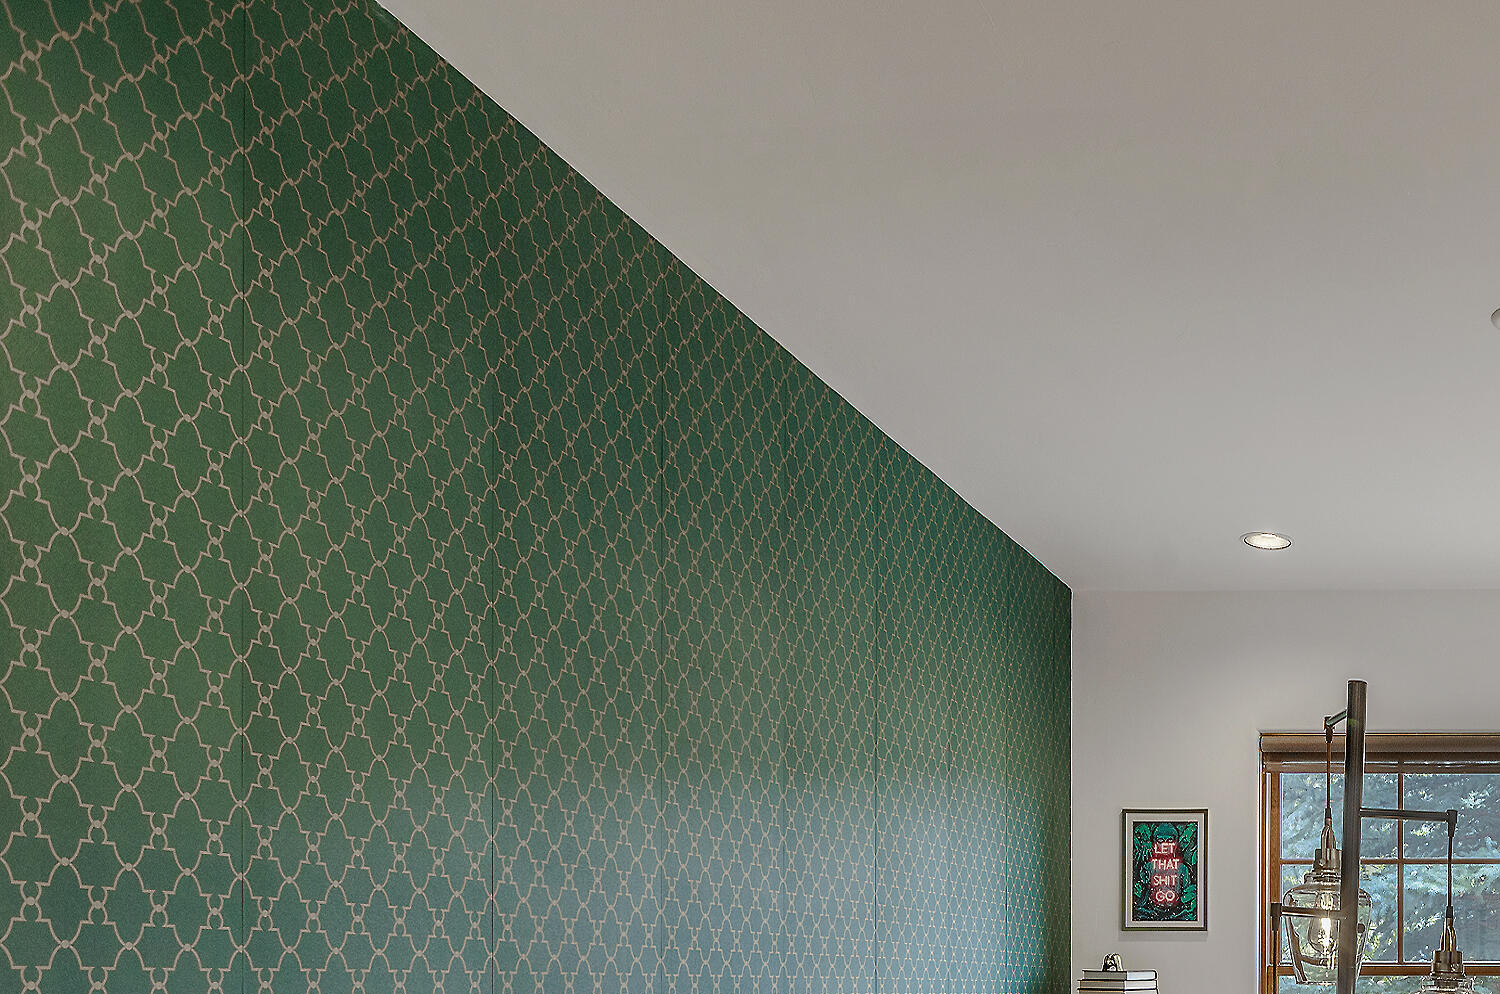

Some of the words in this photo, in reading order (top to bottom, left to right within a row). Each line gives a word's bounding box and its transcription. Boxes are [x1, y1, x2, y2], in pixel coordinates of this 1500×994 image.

[1154, 842, 1175, 854] LET
[1151, 858, 1180, 870] THAT
[1153, 874, 1177, 886] SHIT
[1155, 889, 1175, 902] GO
